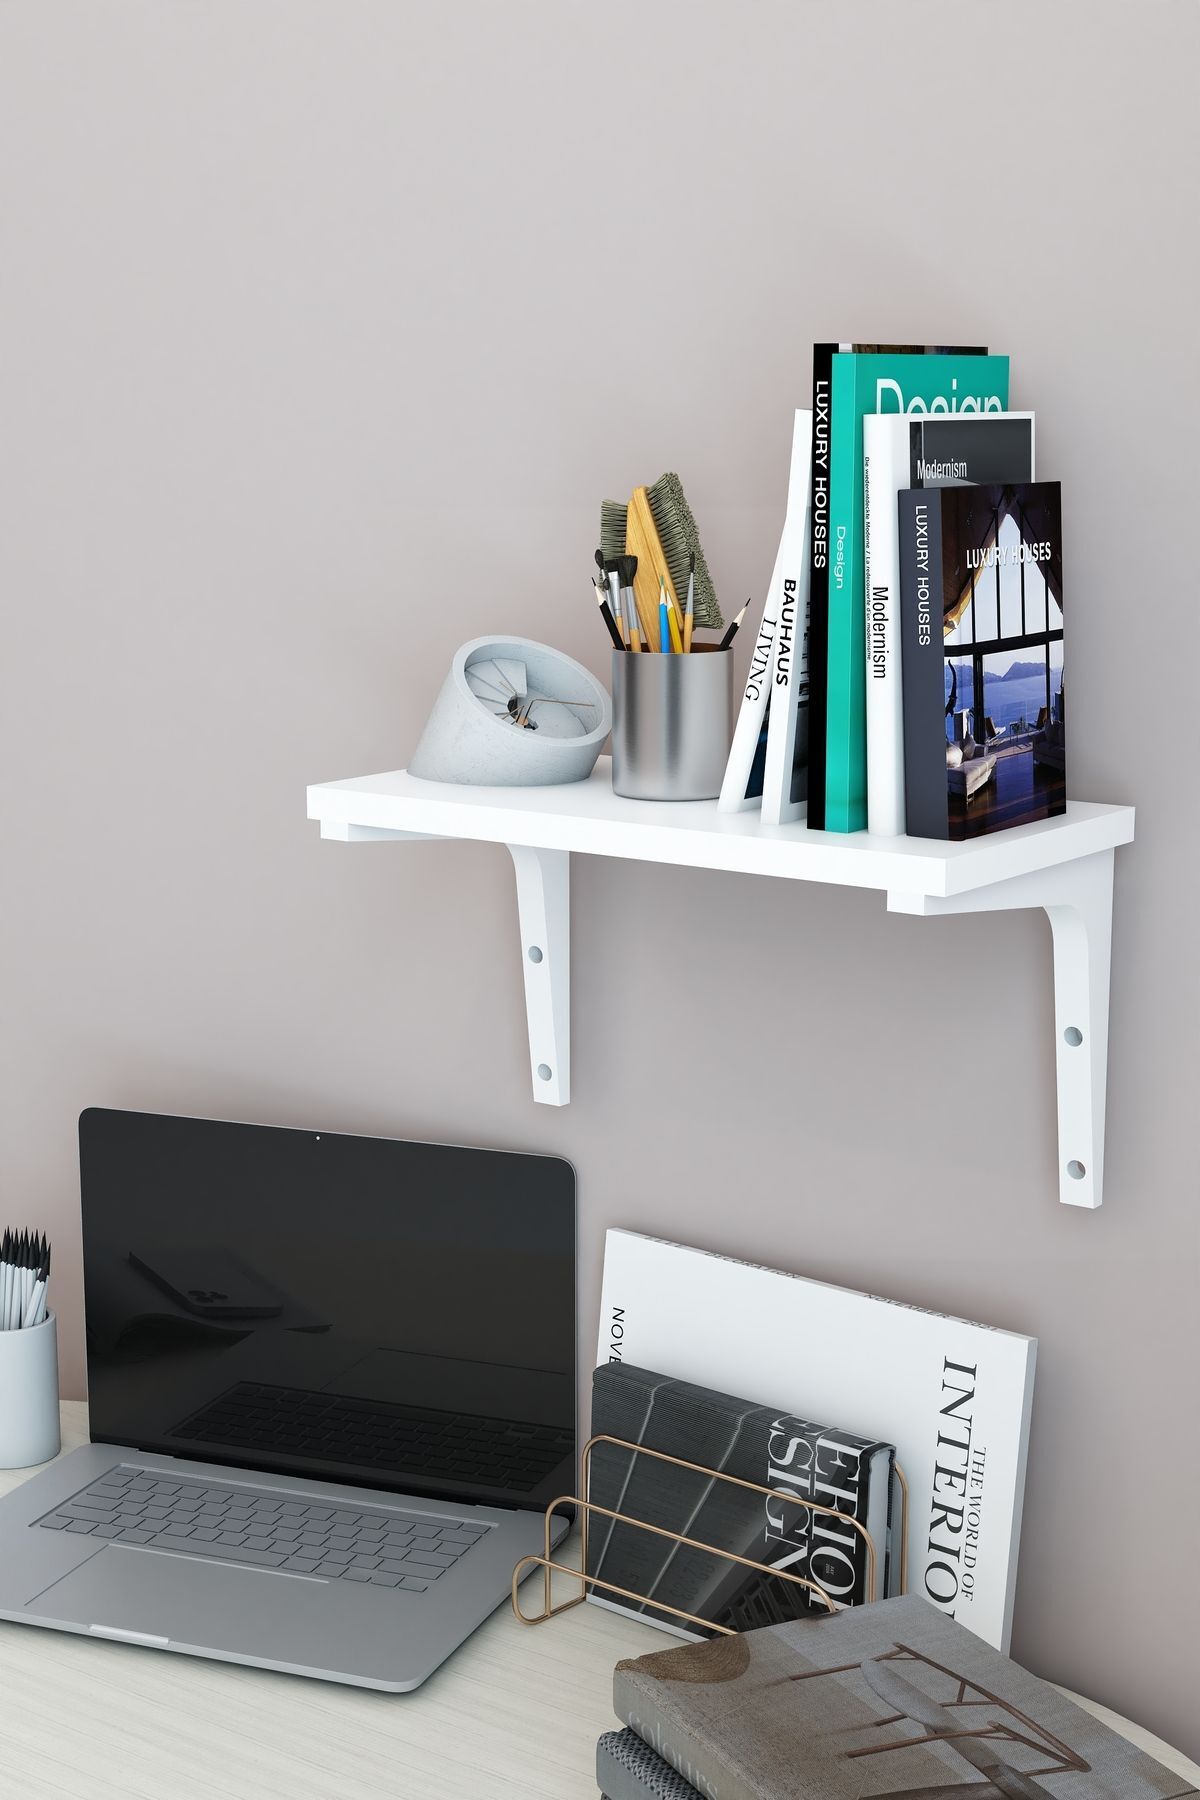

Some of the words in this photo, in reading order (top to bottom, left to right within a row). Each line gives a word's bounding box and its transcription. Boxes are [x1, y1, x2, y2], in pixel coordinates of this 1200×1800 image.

[815, 381, 829, 469] LUXURY
[917, 458, 968, 480] Modernism
[814, 477, 827, 569] HOUSES
[833, 526, 847, 589] Design
[915, 505, 929, 572] LUXURY
[966, 545, 1009, 569] LUXURY
[1011, 541, 1052, 565] HOUSES
[776, 579, 797, 686] BAUHAUS
[872, 587, 890, 678] Modernism
[917, 577, 931, 646] HOUSES
[745, 617, 778, 701] LIVING
[704, 1252, 801, 1279] DECORATION
[863, 1293, 951, 1319] NOVEMBER
[924, 1355, 977, 1620] INTERIO
[970, 1447, 987, 1489] THE
[963, 1494, 982, 1569] WORLD
[961, 1571, 976, 1602] OF
